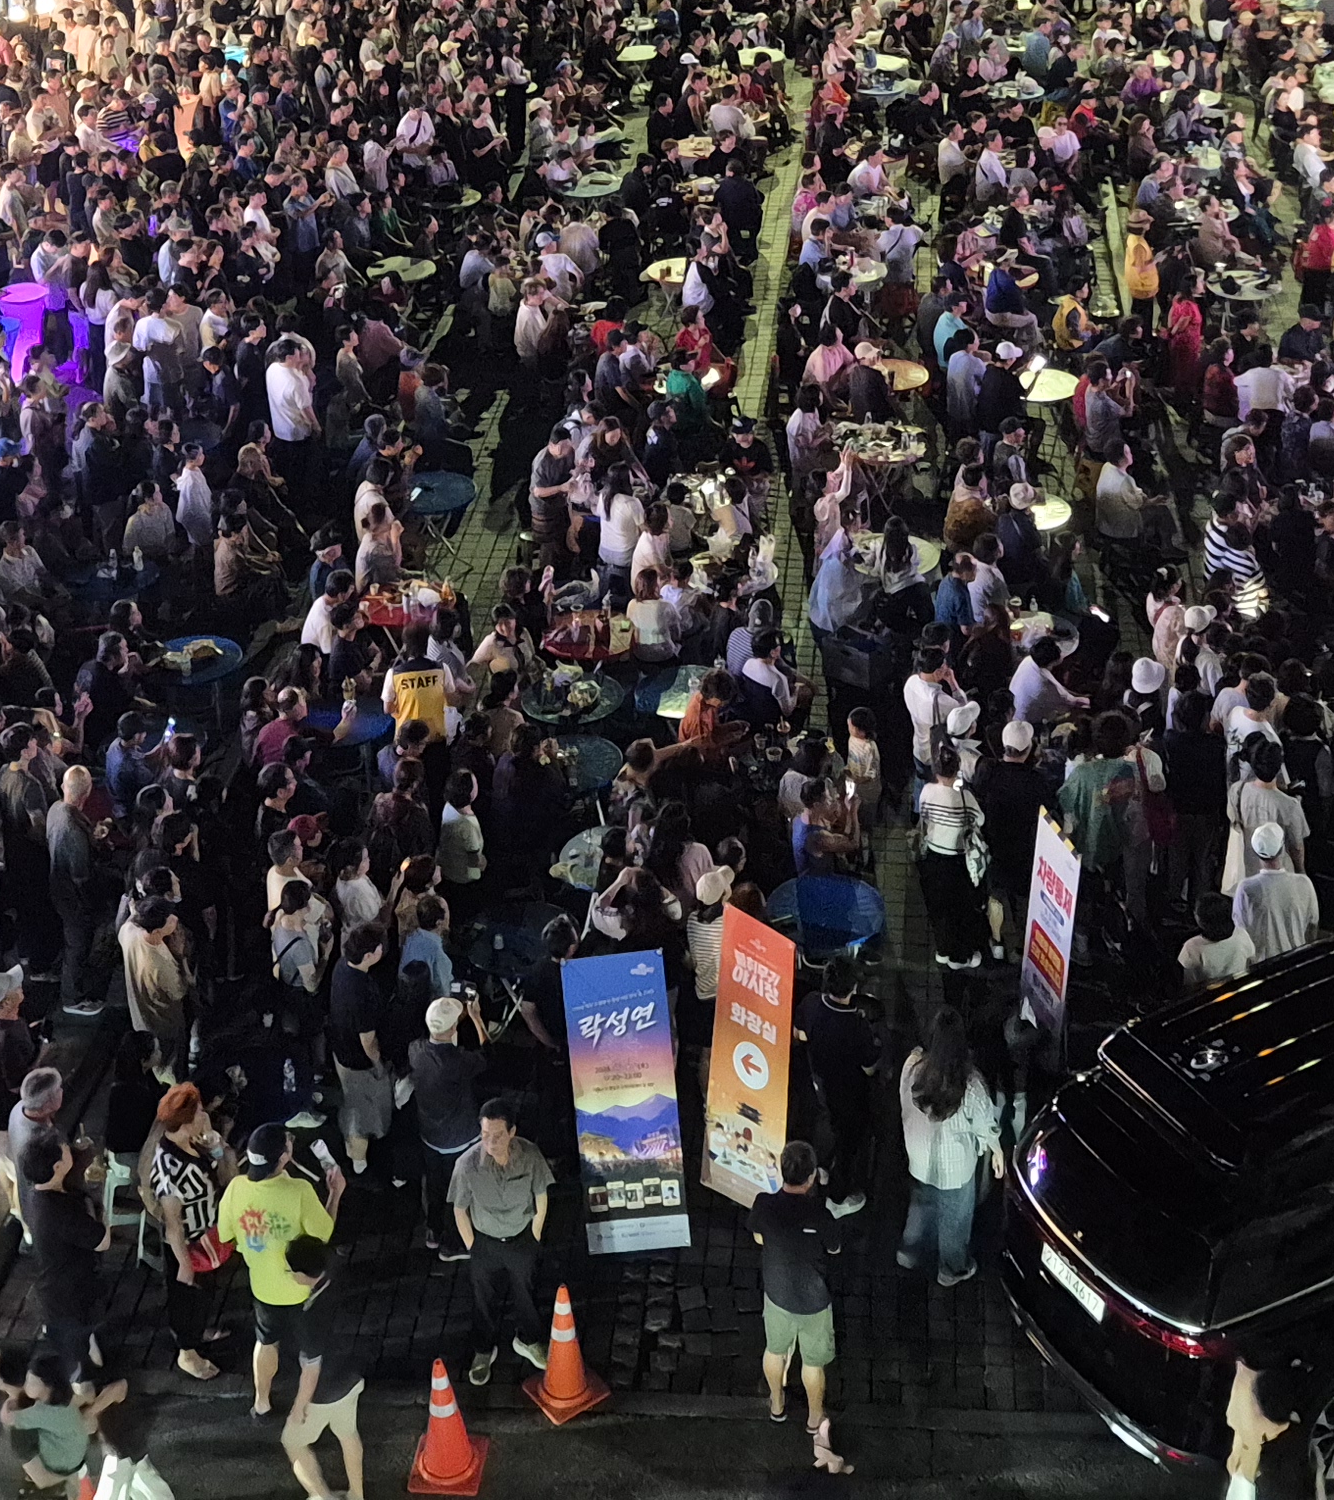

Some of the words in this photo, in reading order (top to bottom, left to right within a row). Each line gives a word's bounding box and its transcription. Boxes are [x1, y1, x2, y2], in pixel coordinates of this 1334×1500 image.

[401, 675, 438, 690] STAFF
[578, 1003, 657, 1047] 락성연
[730, 1002, 777, 1044] 화장실
